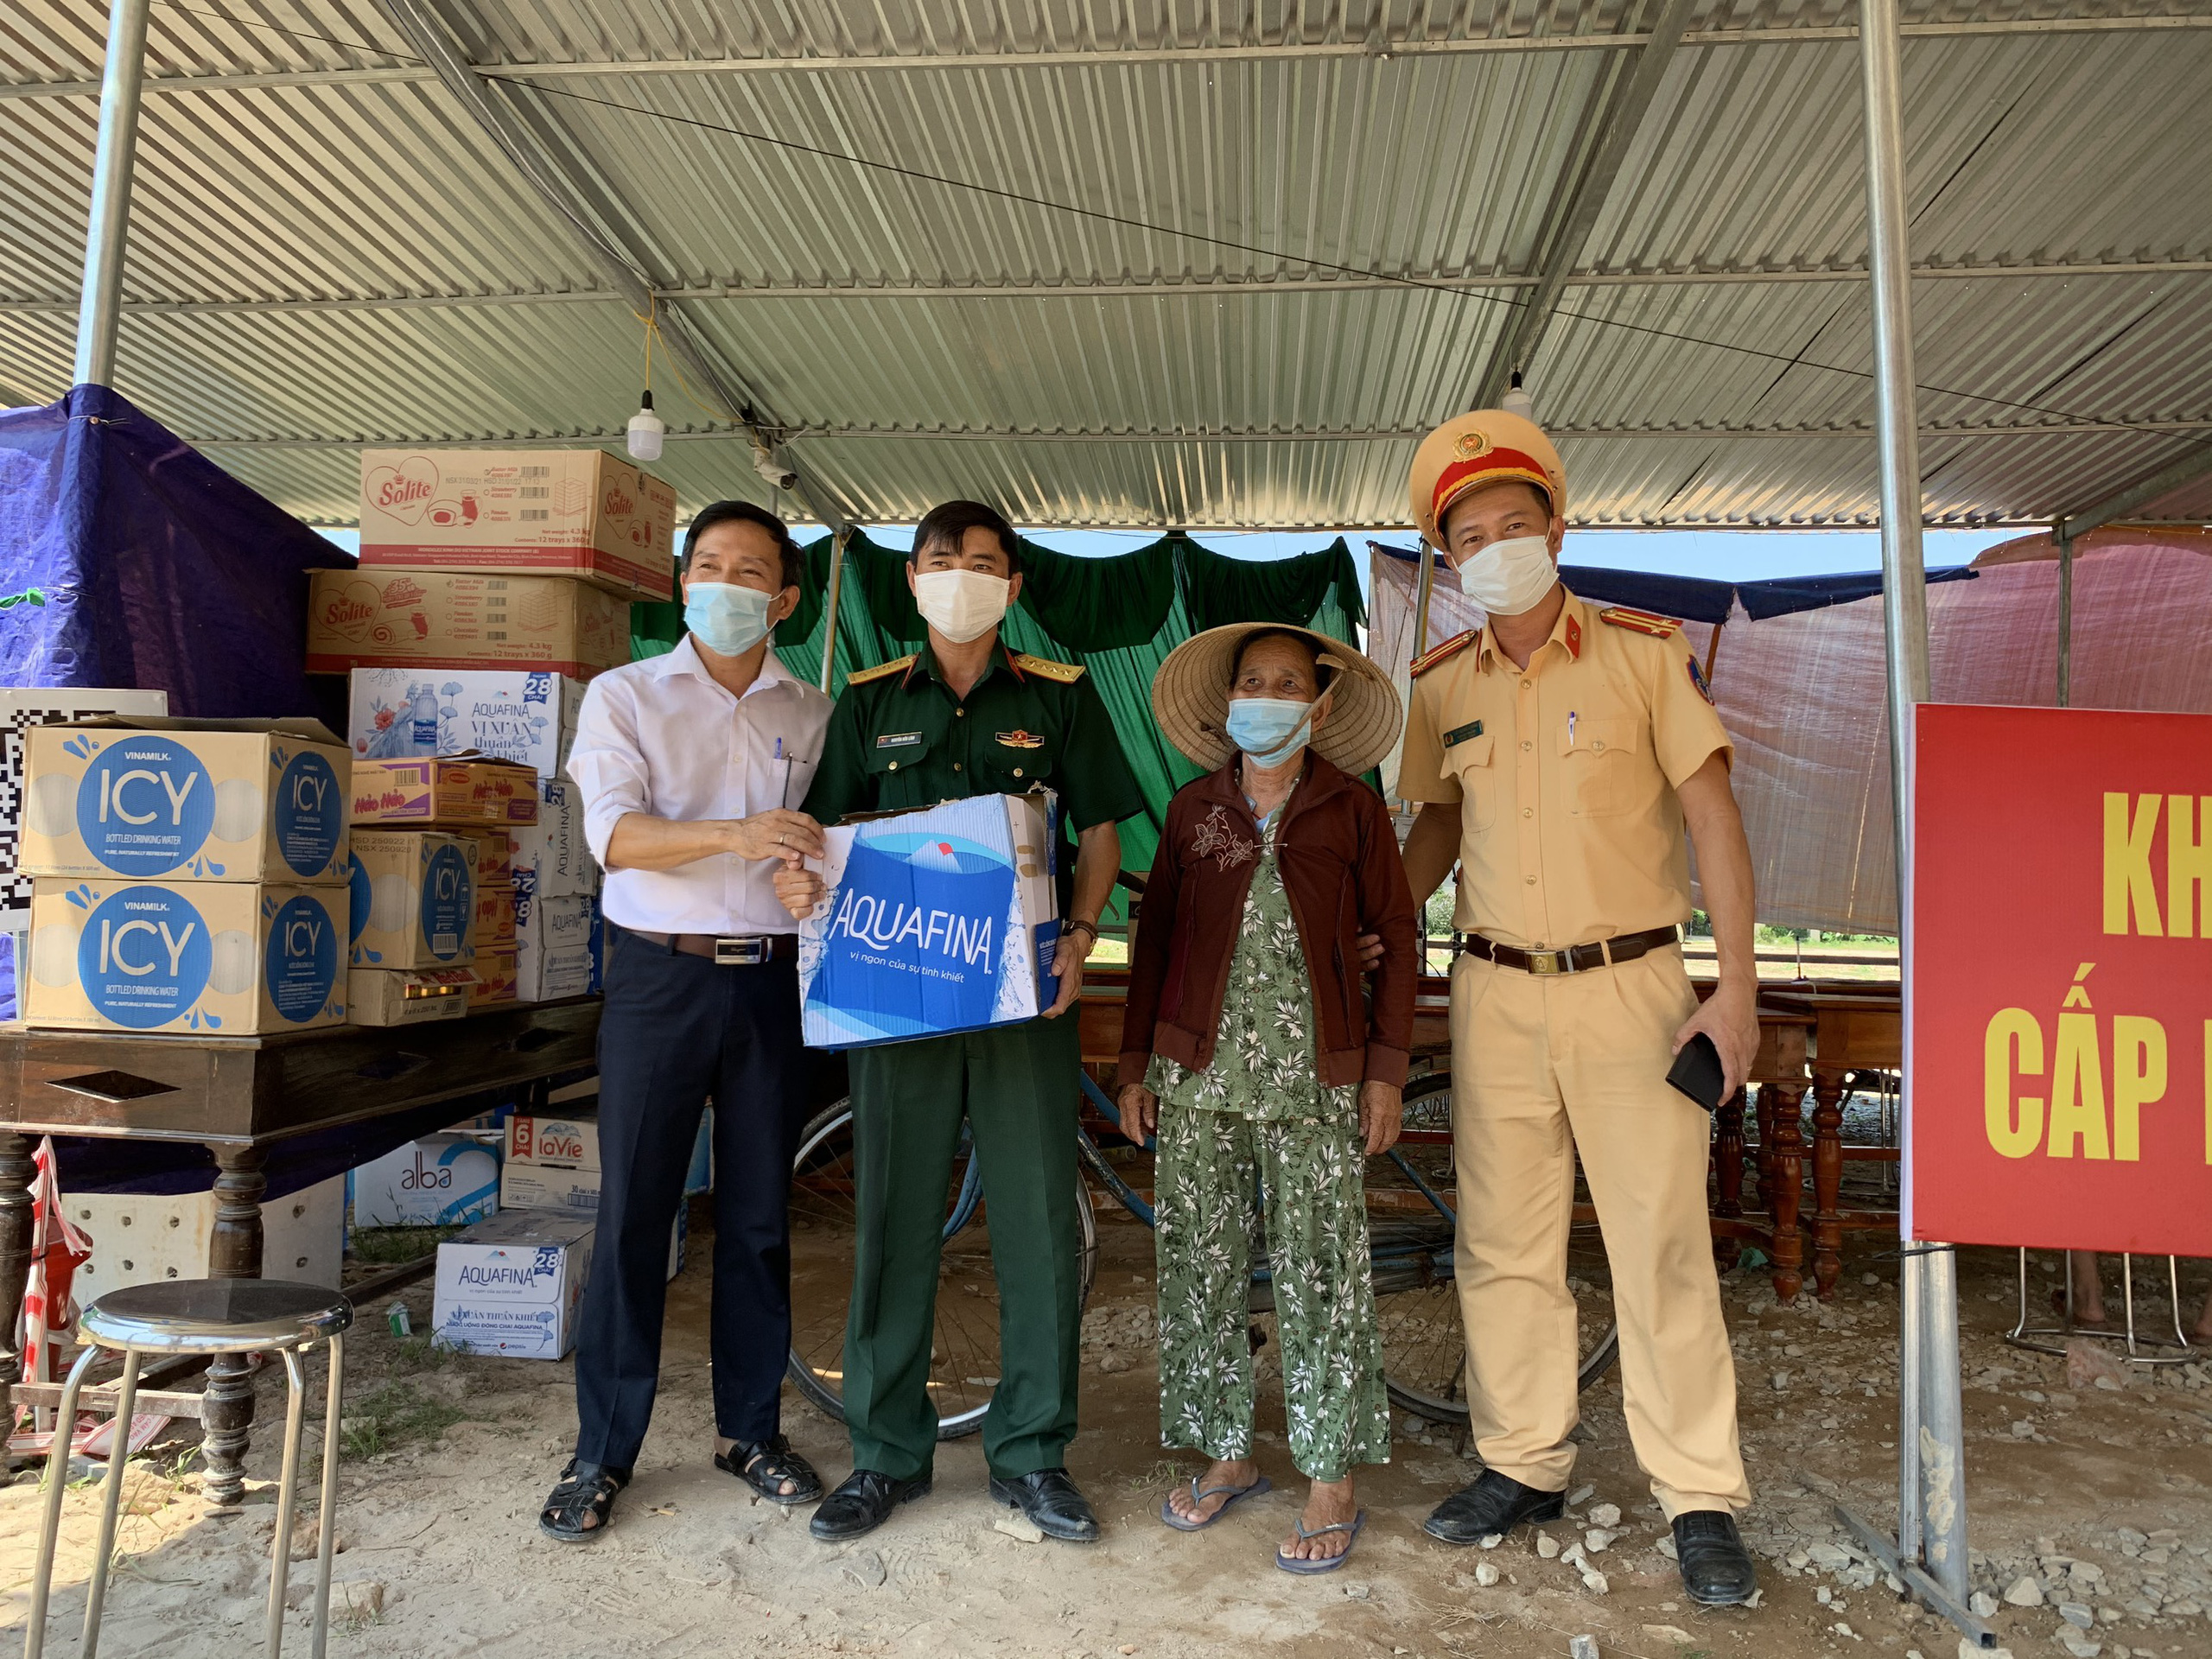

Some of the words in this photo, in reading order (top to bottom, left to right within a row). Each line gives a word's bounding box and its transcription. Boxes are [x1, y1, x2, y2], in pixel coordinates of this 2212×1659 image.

[379, 480, 431, 507] Solite
[605, 492, 633, 515] Solite
[326, 602, 372, 624] Solite
[523, 678, 552, 696] 28
[472, 702, 531, 719] AQUAFINA
[472, 721, 486, 736] VỊ
[491, 718, 532, 736] XUÂN
[124, 752, 169, 760] VINAMILK
[99, 767, 199, 826] ICY
[292, 774, 327, 812] ICY
[354, 793, 379, 814] Hảo
[380, 788, 406, 810] Hảo
[105, 833, 133, 843] BOTTLED
[133, 835, 161, 844] DRINKING
[161, 835, 181, 845] WATER
[379, 845, 411, 854] 250920
[556, 802, 571, 877] AQUAFINA
[435, 868, 461, 900] ICY
[124, 901, 168, 911] VINAMILK
[551, 912, 582, 932] AQUAFINA
[829, 887, 993, 975] AQUAFINA
[99, 918, 196, 978] ICY
[285, 921, 321, 957] ICY
[432, 969, 455, 984] Red
[453, 966, 477, 982] Bull
[850, 950, 859, 962] vị
[861, 954, 887, 966] ngon
[888, 959, 906, 970] của
[909, 964, 921, 975] sự
[921, 966, 939, 978] tinh
[941, 969, 965, 983] khiết
[105, 984, 131, 995] BOTTLED
[132, 985, 159, 995] DRINKING
[159, 987, 179, 996] WATER
[1984, 962, 2168, 1161] CẤP
[516, 1123, 530, 1144] 6
[539, 1136, 583, 1158] laVie
[401, 1151, 452, 1190] alba
[572, 1184, 579, 1193] 30
[534, 1253, 560, 1269] 28
[458, 1265, 535, 1288] AQUAFINA
